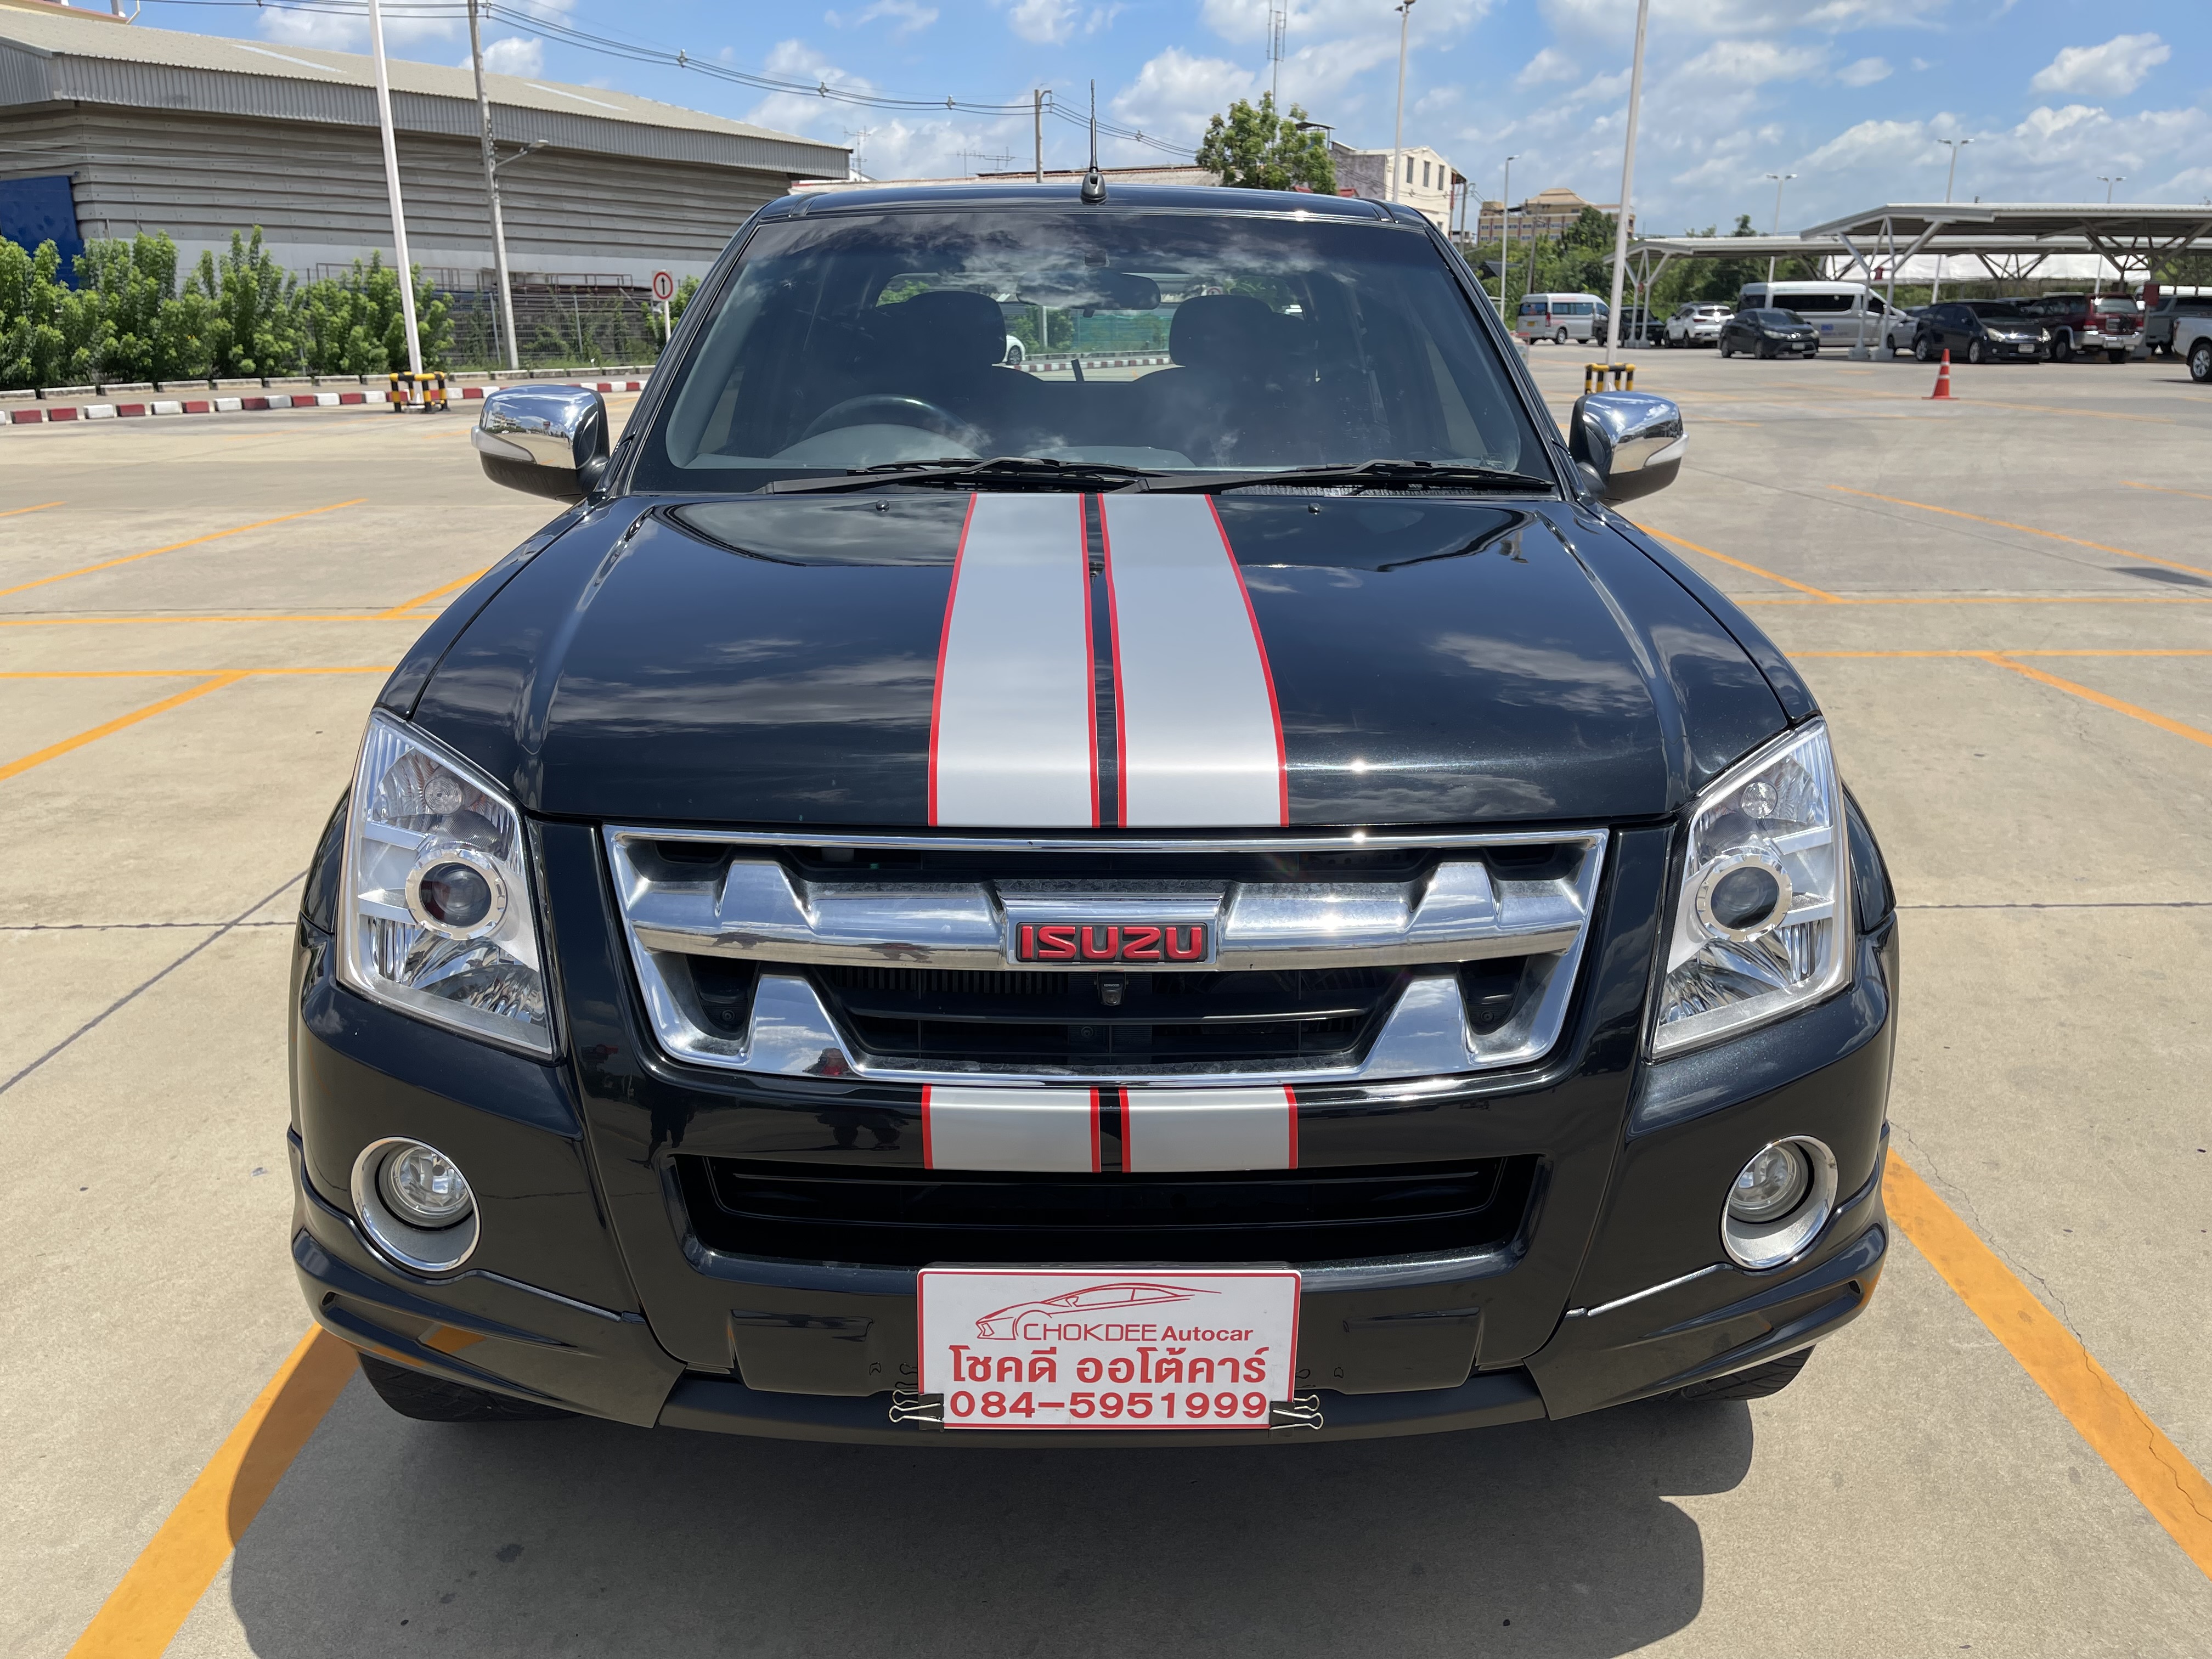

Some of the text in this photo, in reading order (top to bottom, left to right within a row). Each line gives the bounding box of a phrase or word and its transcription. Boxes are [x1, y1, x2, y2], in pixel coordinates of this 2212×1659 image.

[1021, 925, 1203, 959] ISUZU
[1023, 1323, 1254, 1342] CHOKDEE Autocar
[949, 1345, 1269, 1383] โชคดี ออโต้คาร์
[950, 1390, 1267, 1419] 084-5951999
